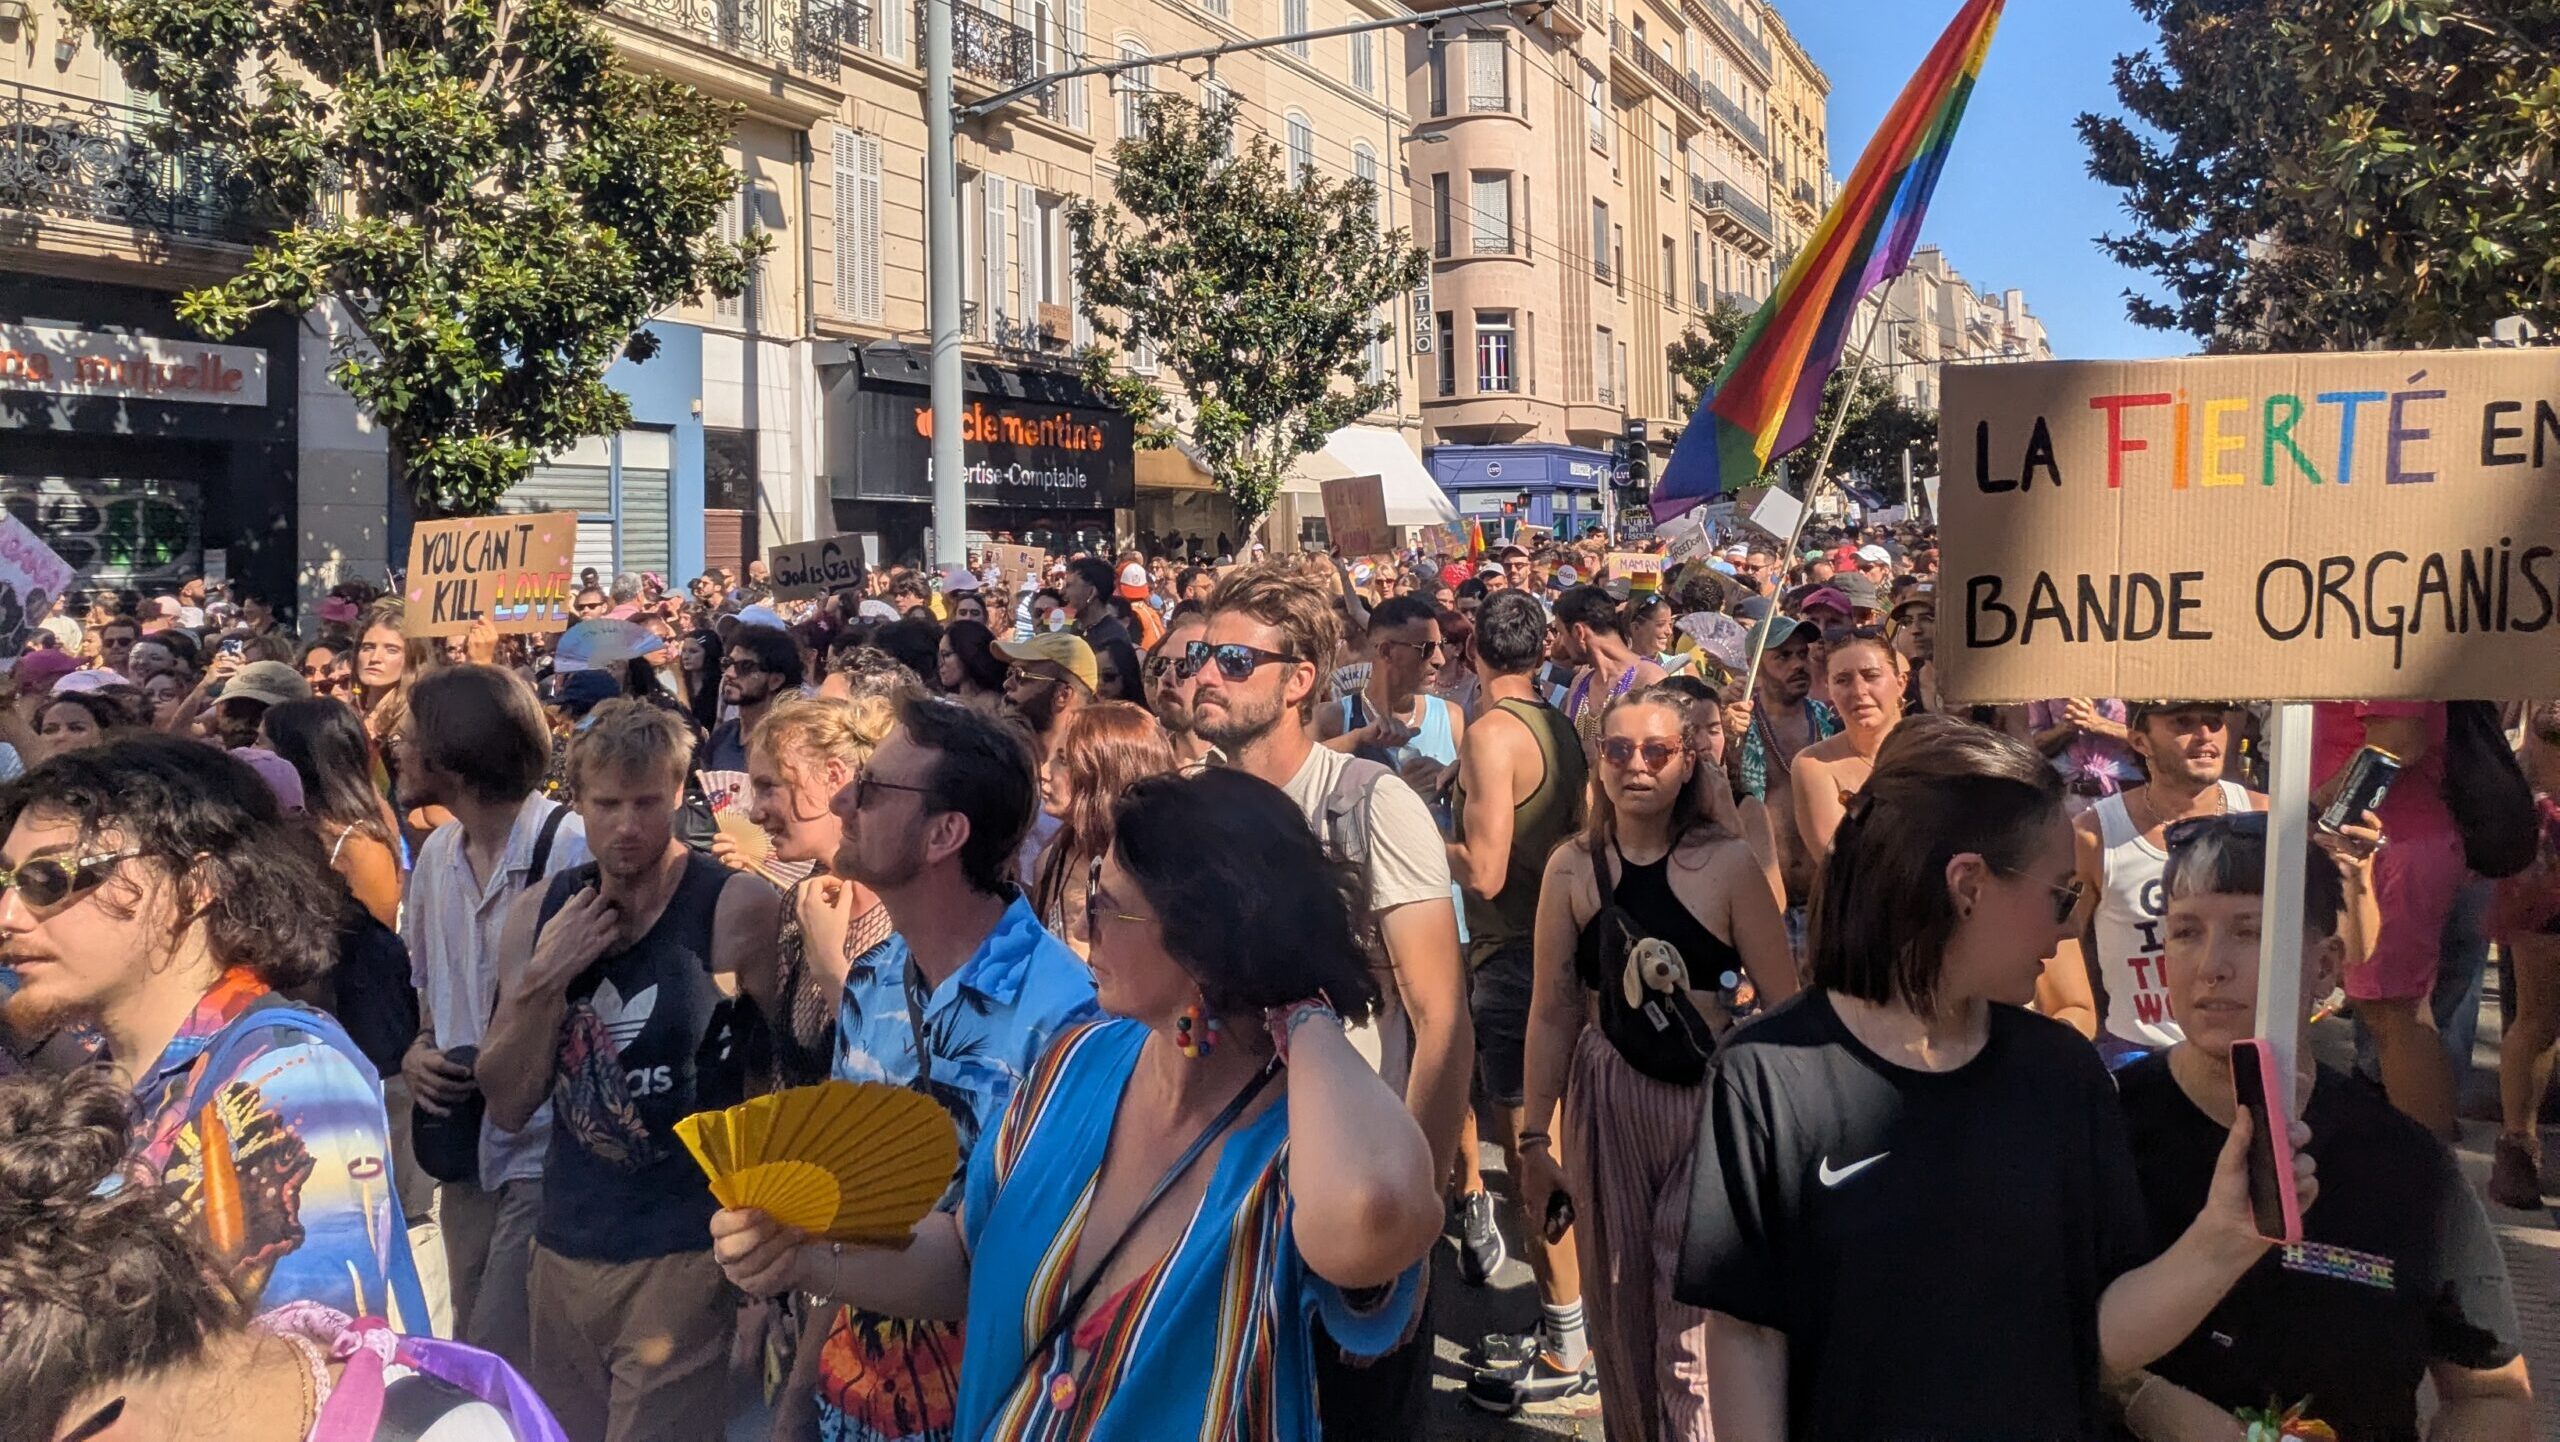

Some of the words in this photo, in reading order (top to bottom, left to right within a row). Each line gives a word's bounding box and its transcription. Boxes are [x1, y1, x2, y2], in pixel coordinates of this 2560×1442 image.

[74, 351, 243, 394] mutuelle
[961, 402, 1104, 451] clementine
[927, 457, 1088, 493] ertise-Comptable
[1976, 415, 2062, 493] LA
[422, 530, 461, 575] YOU
[463, 523, 534, 573] CAN'T
[774, 552, 809, 587] God
[822, 541, 862, 596] Gay
[1620, 558, 1660, 571] MAMAN
[432, 578, 484, 624] KILL
[493, 572, 572, 622] LOVE
[1966, 570, 2214, 649] BANDE
[2254, 537, 2560, 670] ORGANIS
